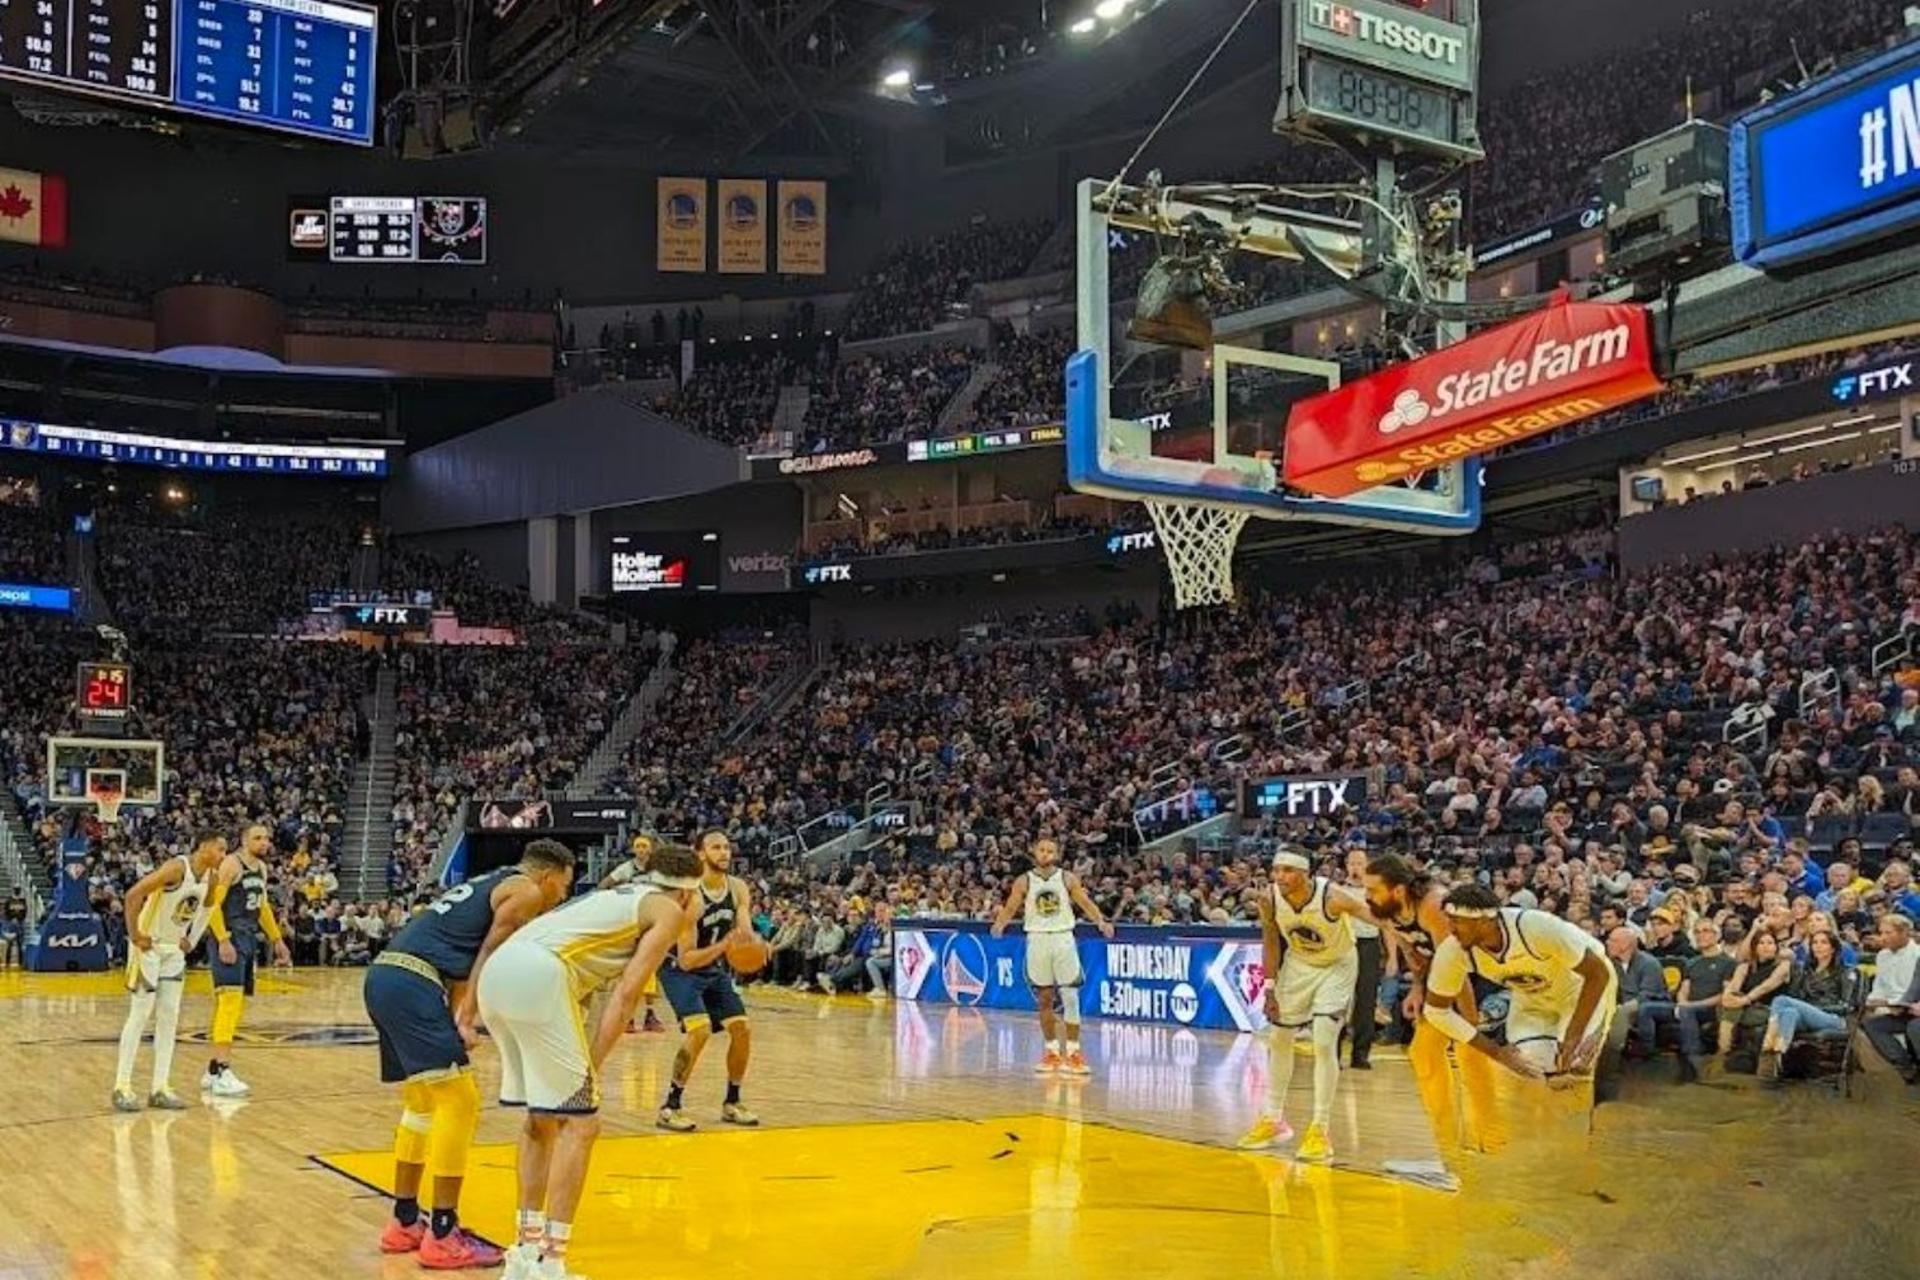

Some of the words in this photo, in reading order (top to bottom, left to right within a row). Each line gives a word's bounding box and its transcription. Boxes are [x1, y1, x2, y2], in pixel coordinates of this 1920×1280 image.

[1354, 10, 1462, 63] TISSOT
[28, 56, 52, 71] 17.2
[1859, 362, 1912, 396] FTX
[1030, 427, 1063, 441] FINAL
[1122, 530, 1155, 551] FTX
[820, 564, 851, 581] FTX
[374, 608, 409, 624] FTX
[88, 681, 119, 705] 24
[1287, 778, 1349, 815] FTX
[884, 814, 905, 826] FTX
[1107, 943, 1191, 981] WEDNESDAY
[1100, 980, 1152, 1018] 9:30PM
[1153, 989, 1168, 1018] ET
